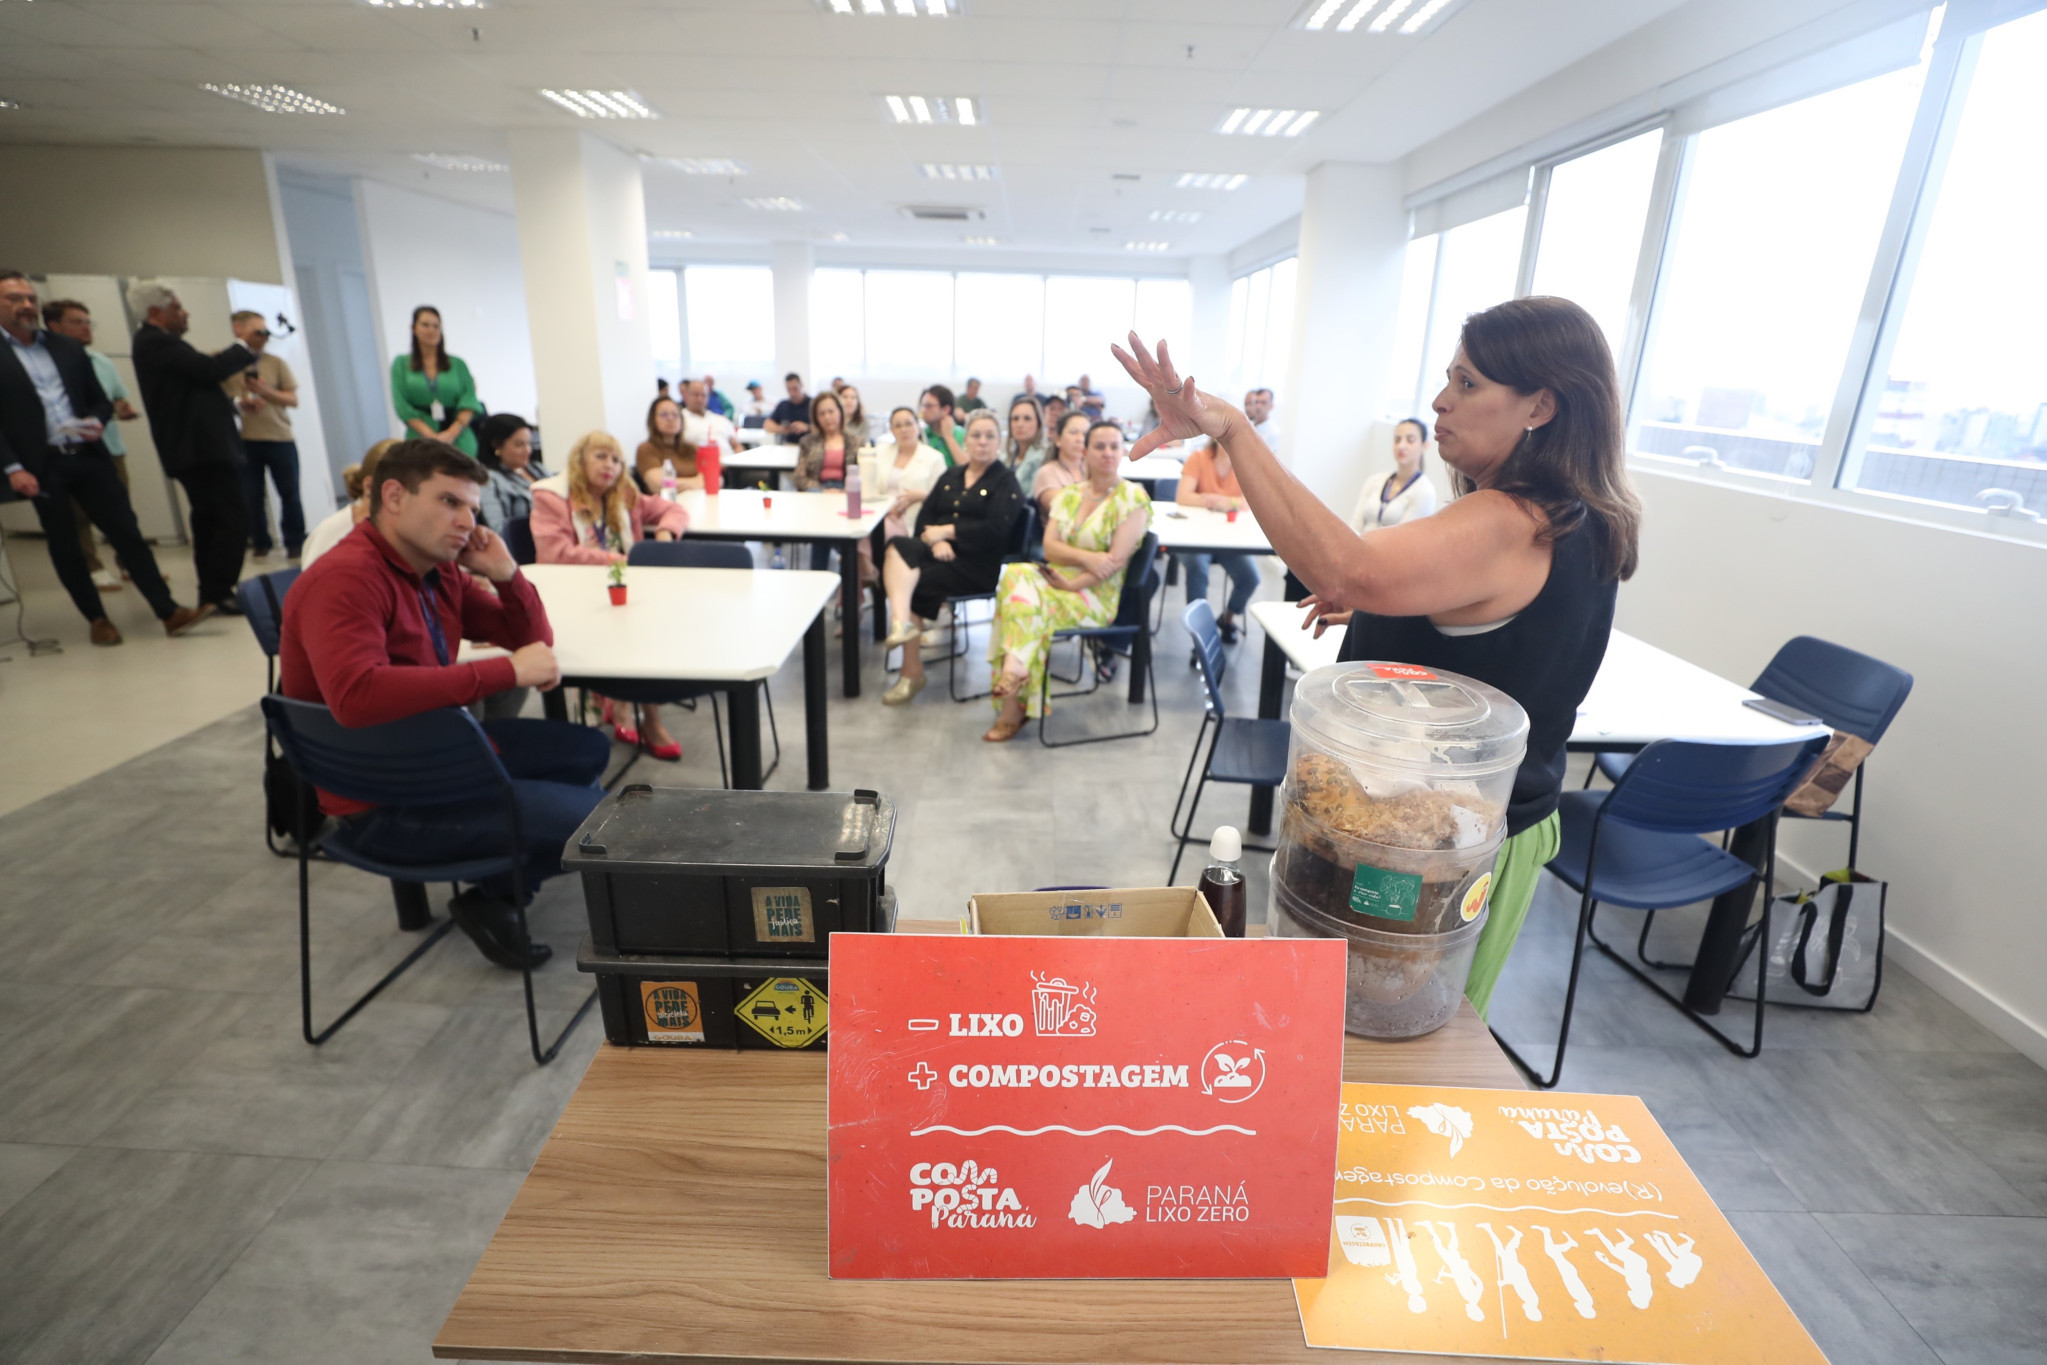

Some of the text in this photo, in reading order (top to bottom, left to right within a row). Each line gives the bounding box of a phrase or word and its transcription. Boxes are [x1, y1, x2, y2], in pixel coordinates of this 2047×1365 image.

[765, 895, 800, 907] A VIDA
[768, 922, 803, 937] MAIS
[653, 989, 688, 1000] A VIDA
[775, 1025, 795, 1036] 1,5
[948, 1013, 1024, 1037] LIXO
[948, 1064, 1189, 1088] COMPOSTAGEM
[1355, 1103, 1400, 1118] LIXO
[1339, 1117, 1407, 1135] PARA
[1517, 1119, 1631, 1144] POSTA
[909, 1159, 998, 1186] COM
[1146, 1180, 1249, 1205] PARANÁ
[1489, 1176, 1521, 1194] da
[1526, 1175, 1663, 1202] (R)evolução
[909, 1184, 1022, 1214] POSTA
[931, 1204, 1037, 1230] Paraná
[1146, 1206, 1250, 1222] LIXO ZERO
